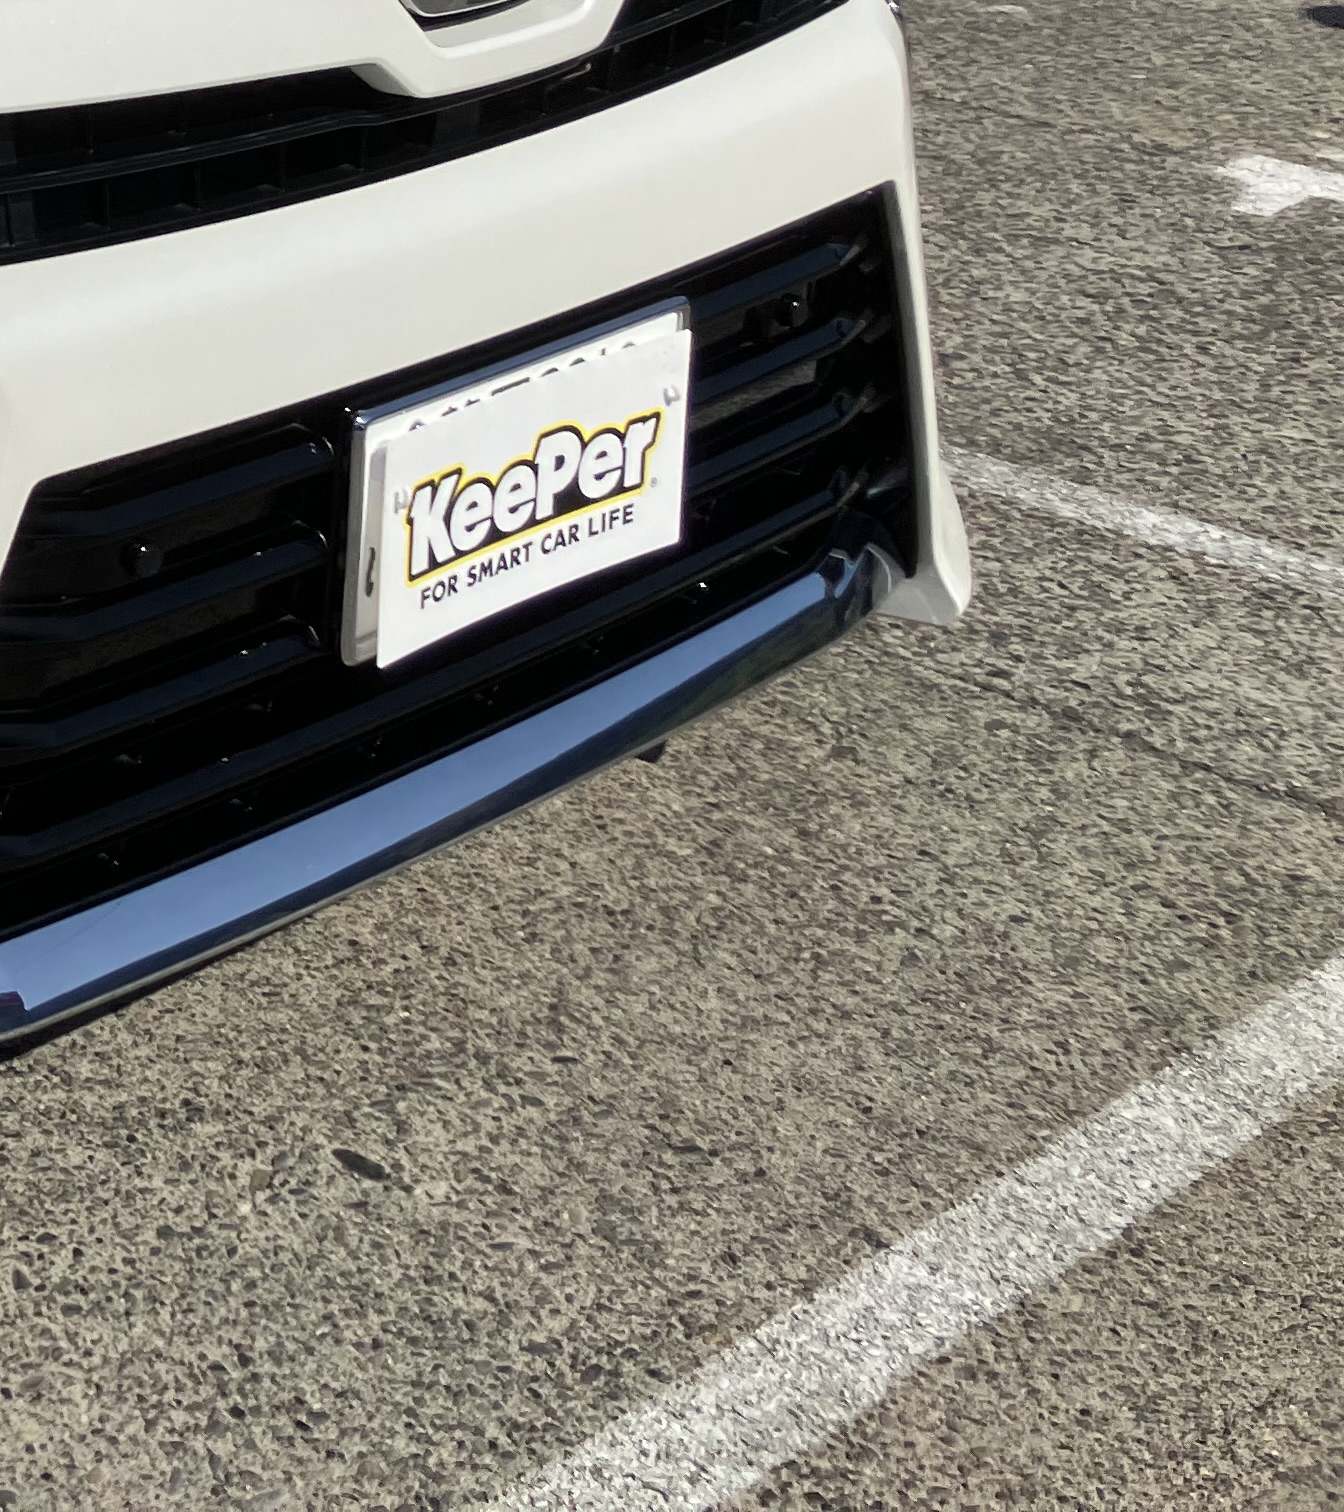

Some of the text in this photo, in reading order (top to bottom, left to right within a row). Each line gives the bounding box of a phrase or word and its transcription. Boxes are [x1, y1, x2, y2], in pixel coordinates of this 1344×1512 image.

[407, 409, 661, 583] KeePer
[420, 503, 635, 609] FOR SMART CAR LIFE
